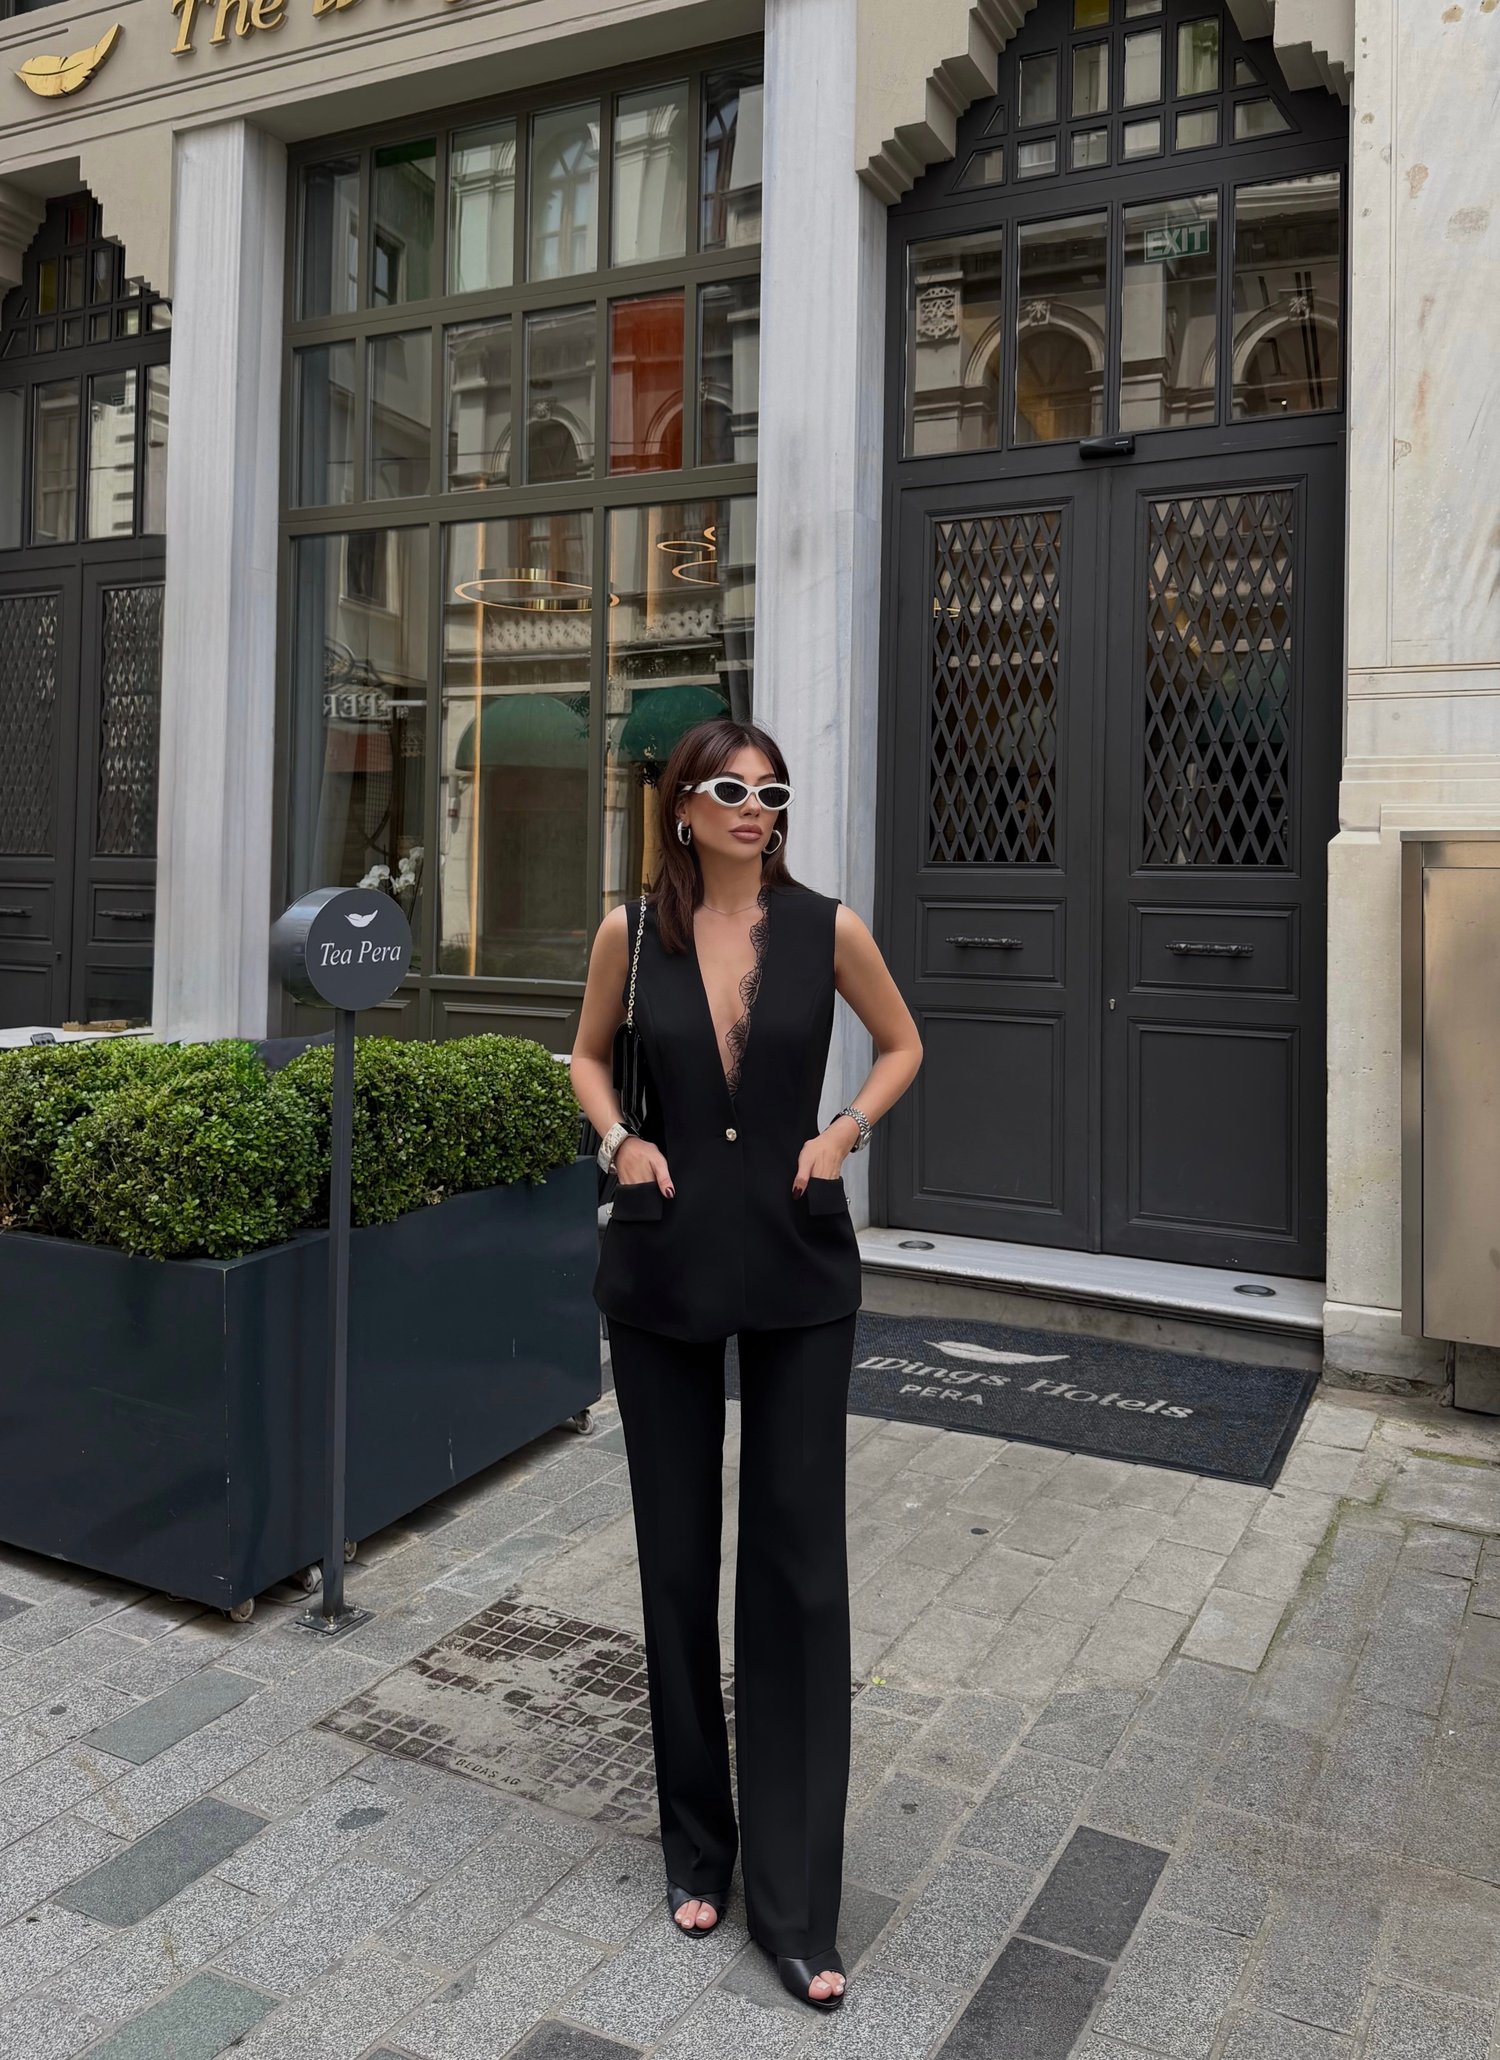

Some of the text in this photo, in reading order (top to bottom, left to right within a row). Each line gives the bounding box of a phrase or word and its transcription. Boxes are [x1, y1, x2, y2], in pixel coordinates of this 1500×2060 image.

[171, 0, 286, 56] The
[1147, 224, 1207, 258] EXIT
[320, 940, 402, 967] Tea Pera
[854, 1356, 1194, 1419] Wings Hotels
[899, 1383, 984, 1406] PERA
